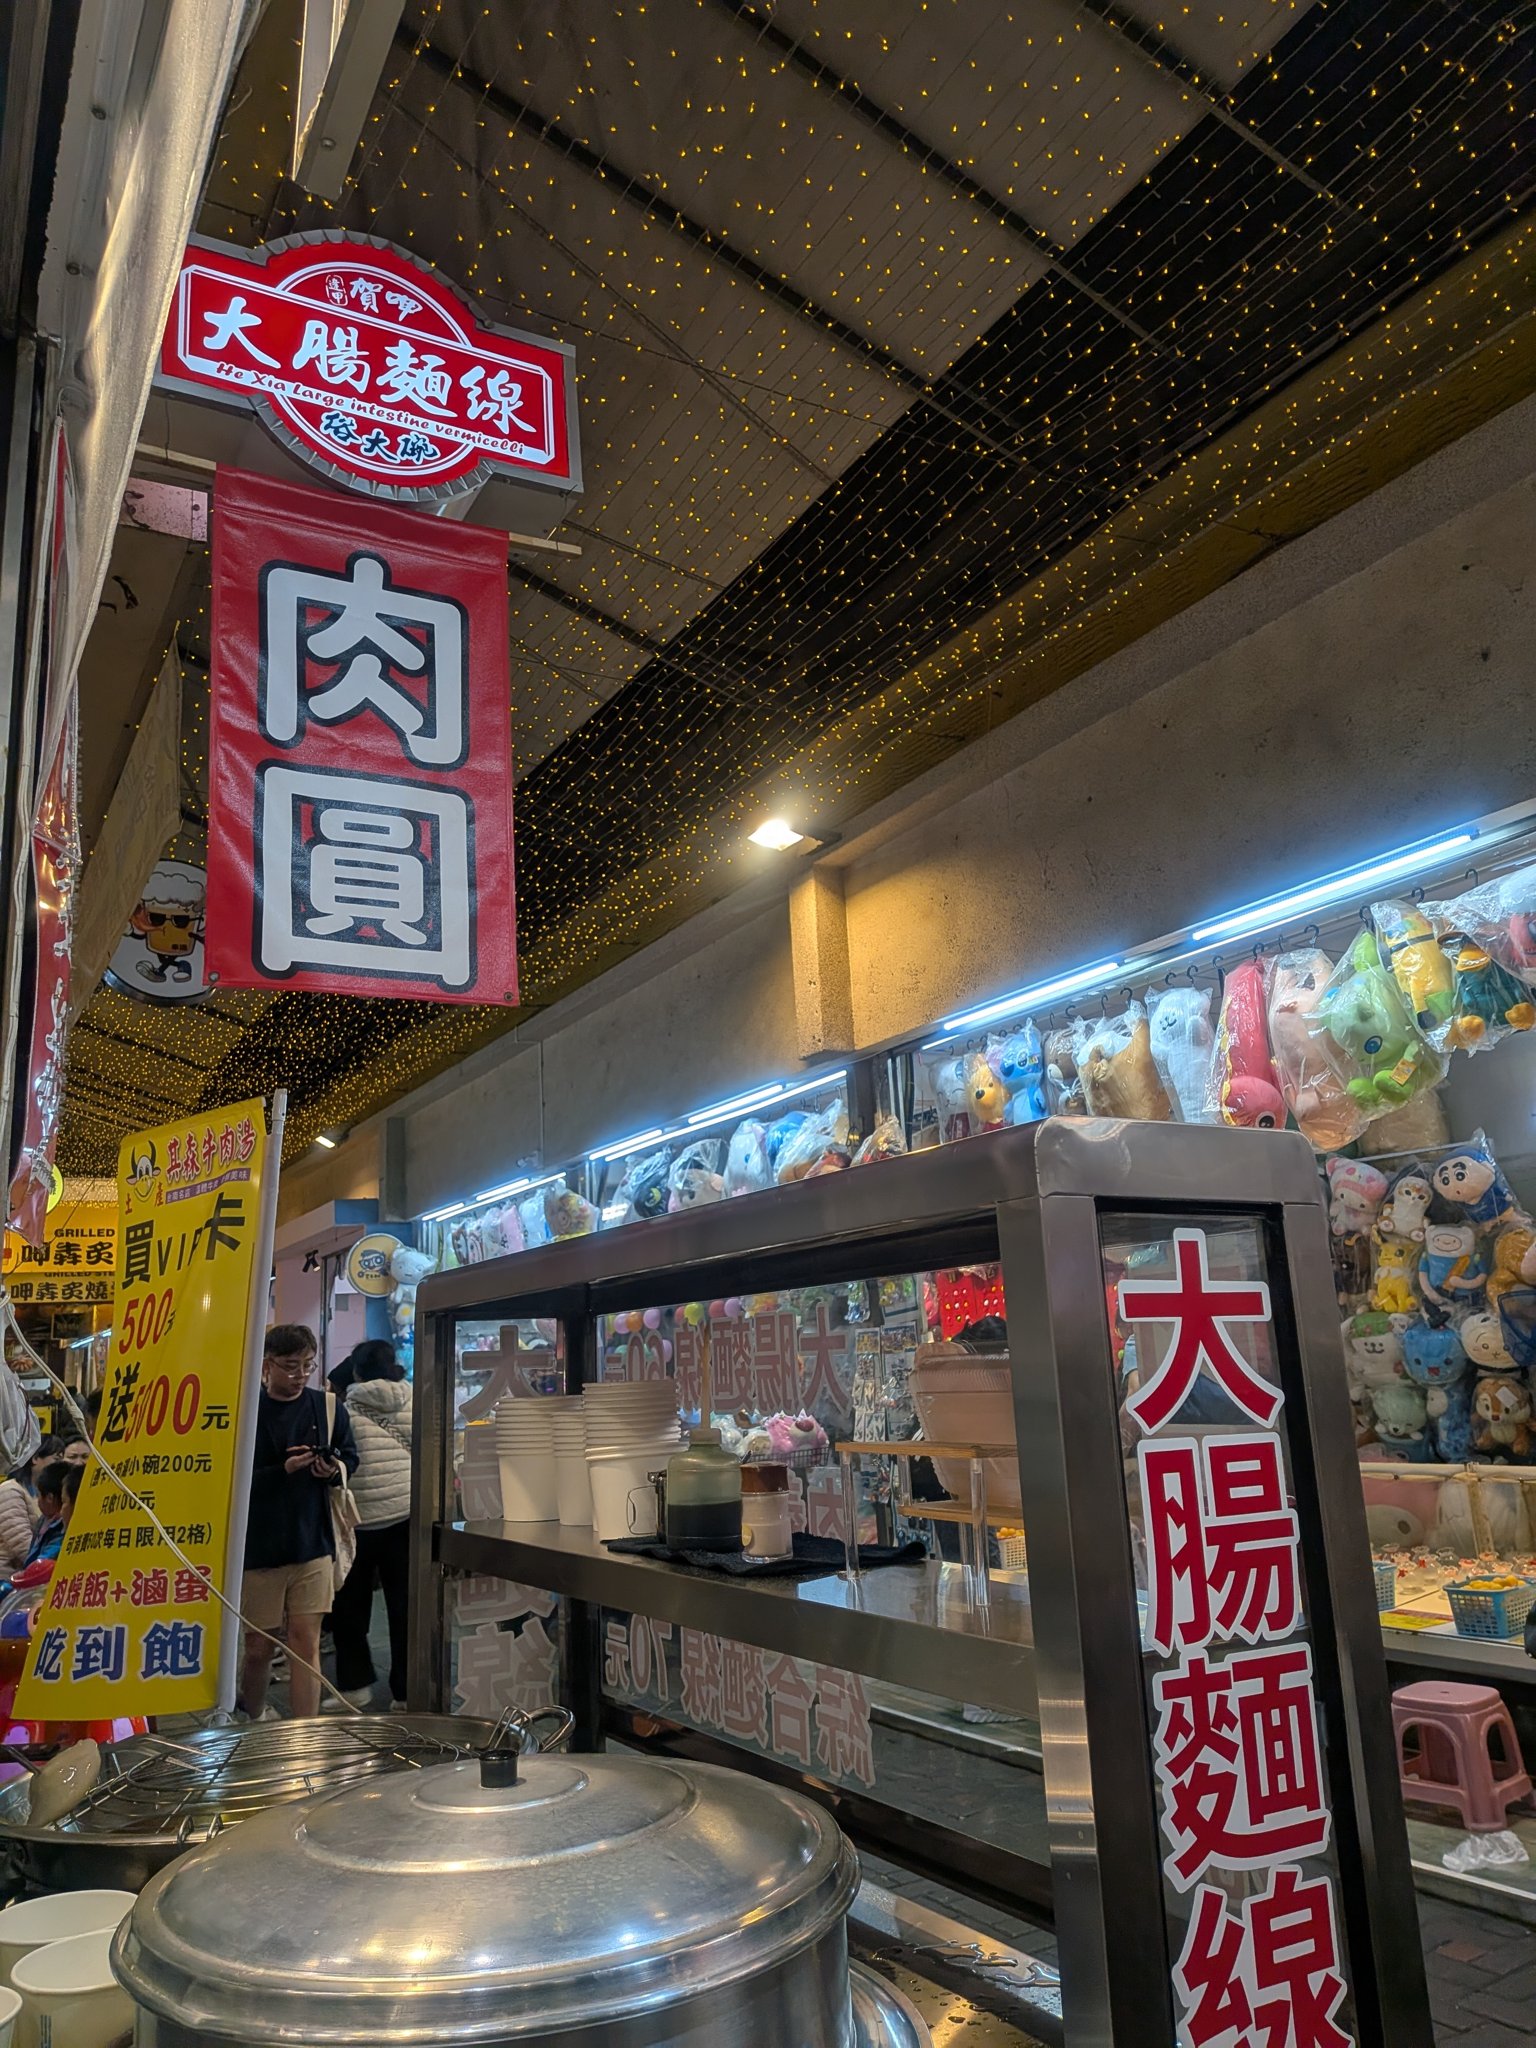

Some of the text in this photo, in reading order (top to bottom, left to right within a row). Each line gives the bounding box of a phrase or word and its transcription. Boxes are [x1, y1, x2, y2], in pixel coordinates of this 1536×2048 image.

[349, 277, 423, 322] 賀呷
[203, 296, 536, 434] 大腸麵線
[216, 363, 525, 455] He Xia Large intestine vermicelli
[323, 411, 439, 464] 俗大碗
[256, 553, 473, 990] 肉圓
[167, 1118, 257, 1184] 其森牛肉湯
[54, 1228, 115, 1238] GRILLED
[10, 1281, 115, 1301] 呷犇炙燒
[33, 1621, 204, 1682] 吃到飽
[1119, 1229, 1354, 2048] 大腸麵線
